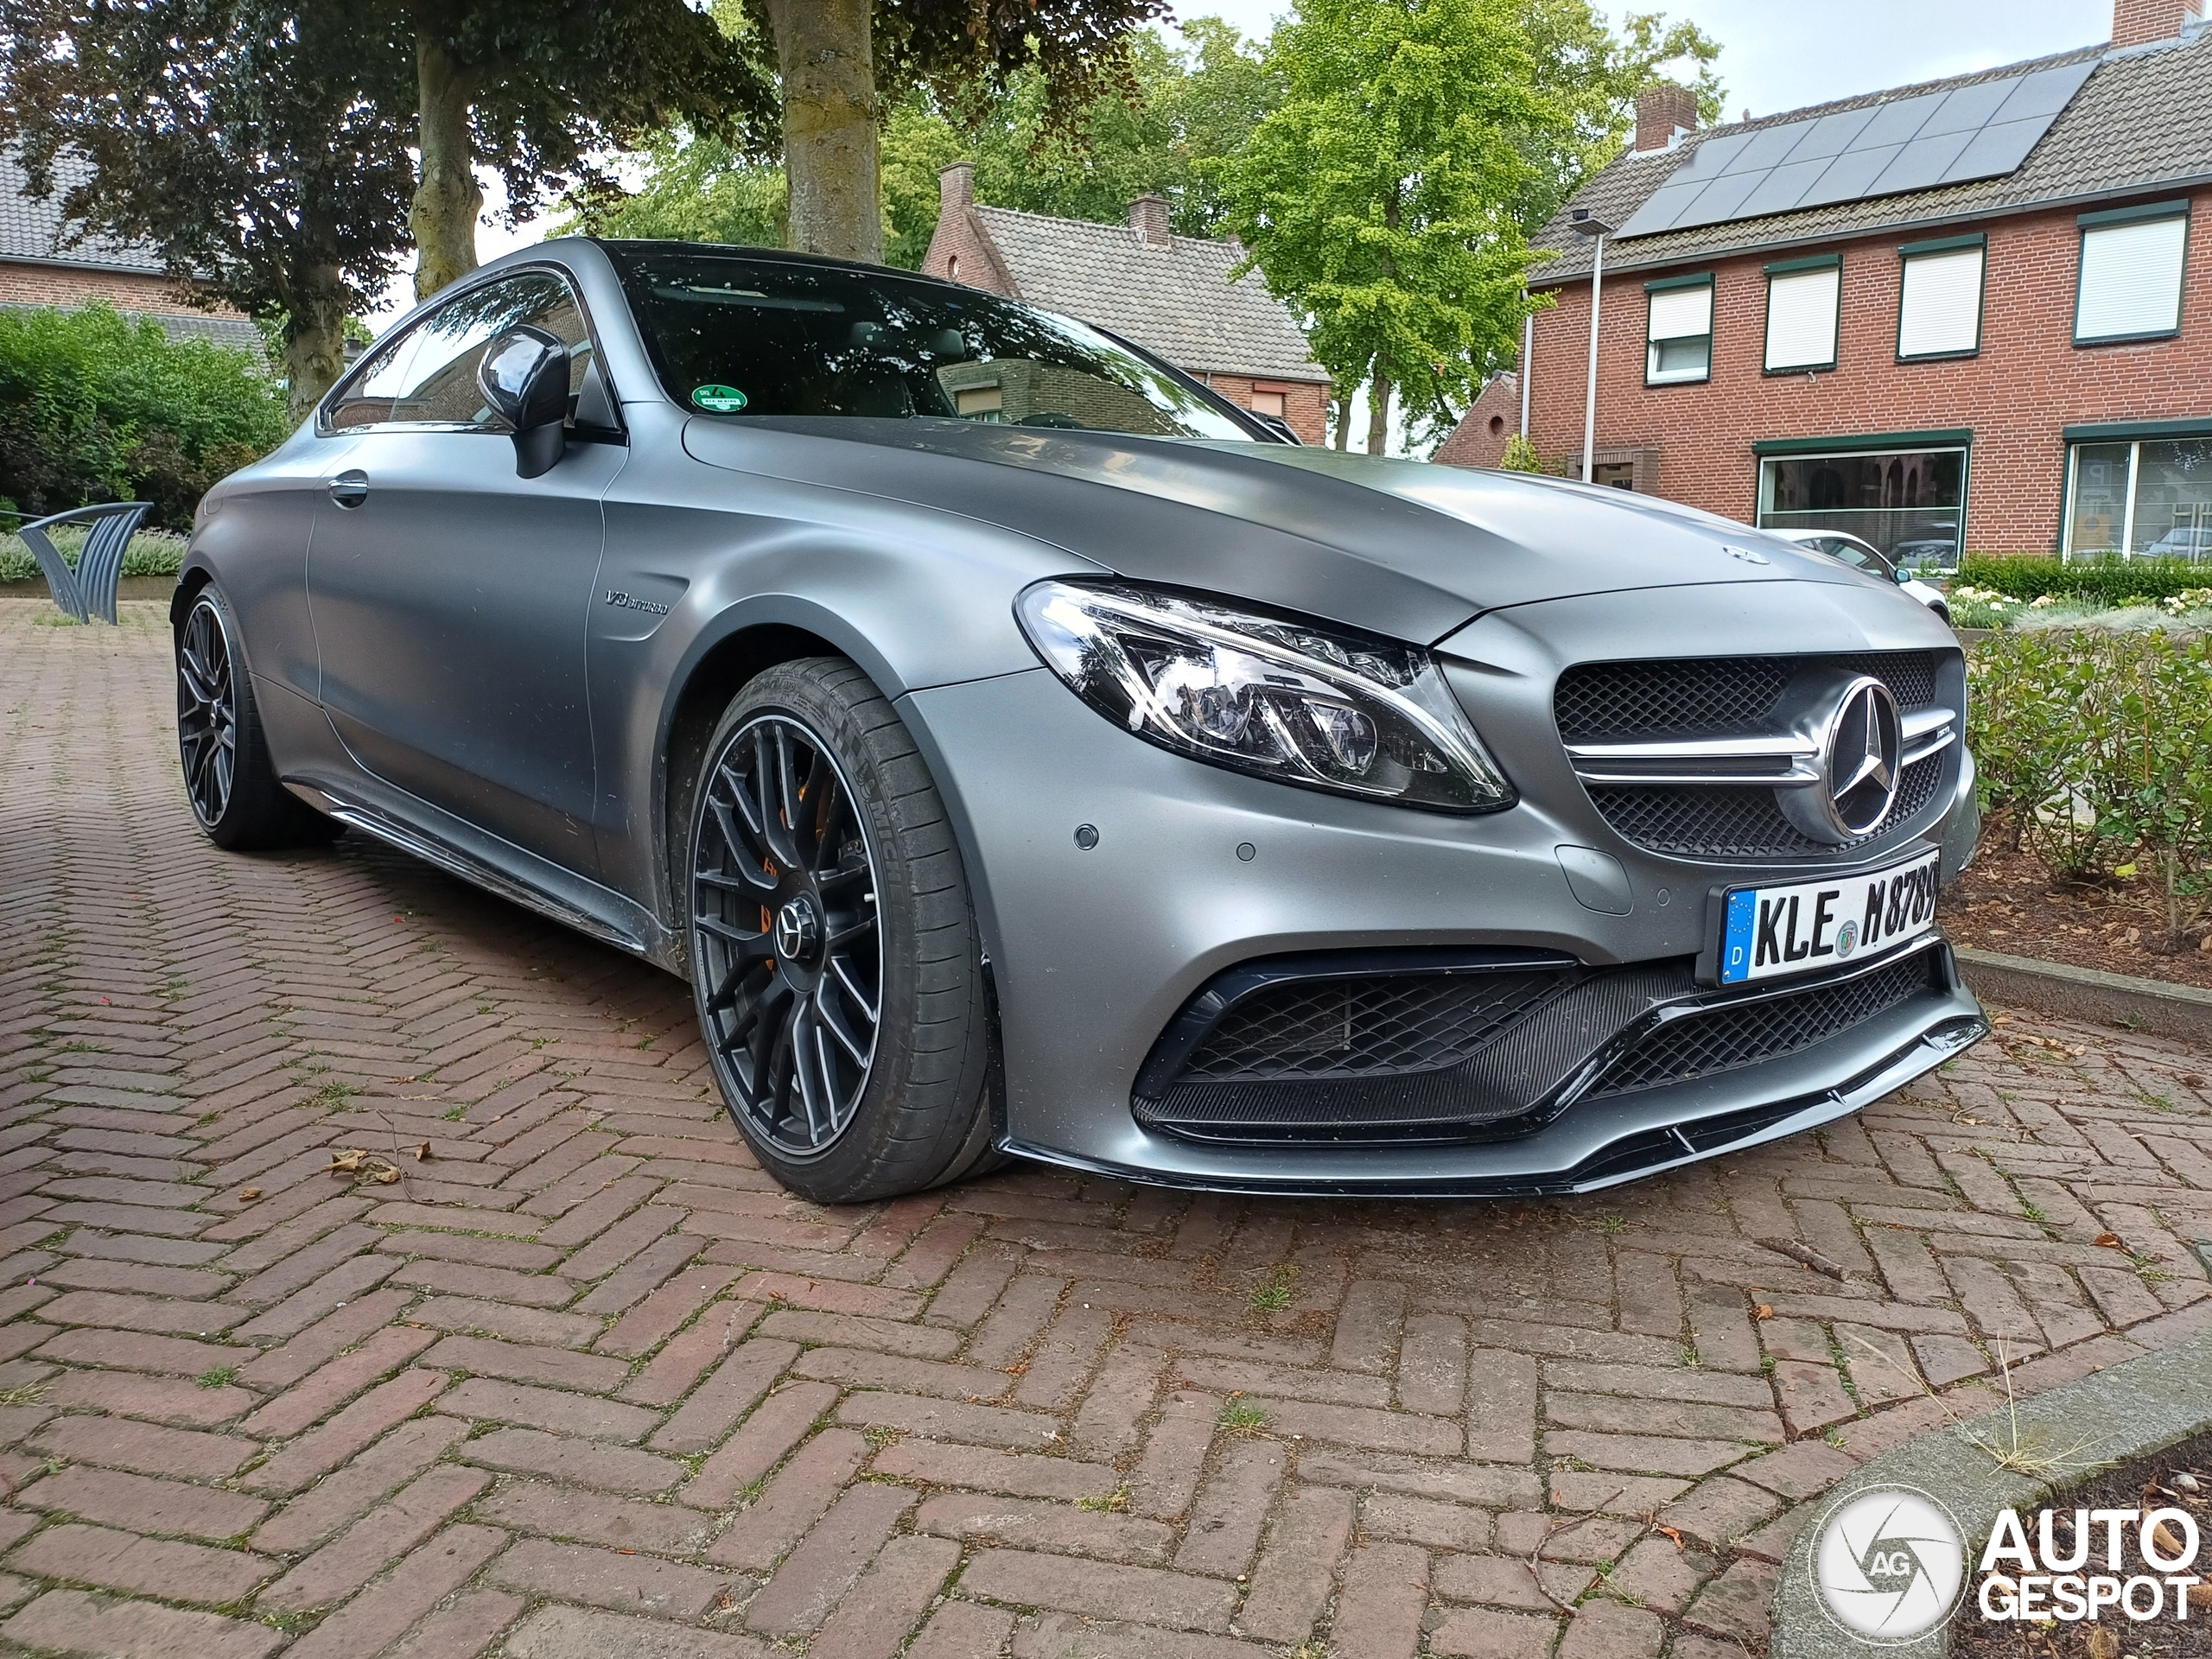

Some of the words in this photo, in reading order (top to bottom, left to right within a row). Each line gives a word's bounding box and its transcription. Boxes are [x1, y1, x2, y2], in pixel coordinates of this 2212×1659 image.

[711, 387, 726, 398] 4
[606, 589, 629, 607] V8
[628, 599, 669, 615] BITURBO
[1755, 890, 1840, 967] KLE
[1731, 946, 1743, 966] D
